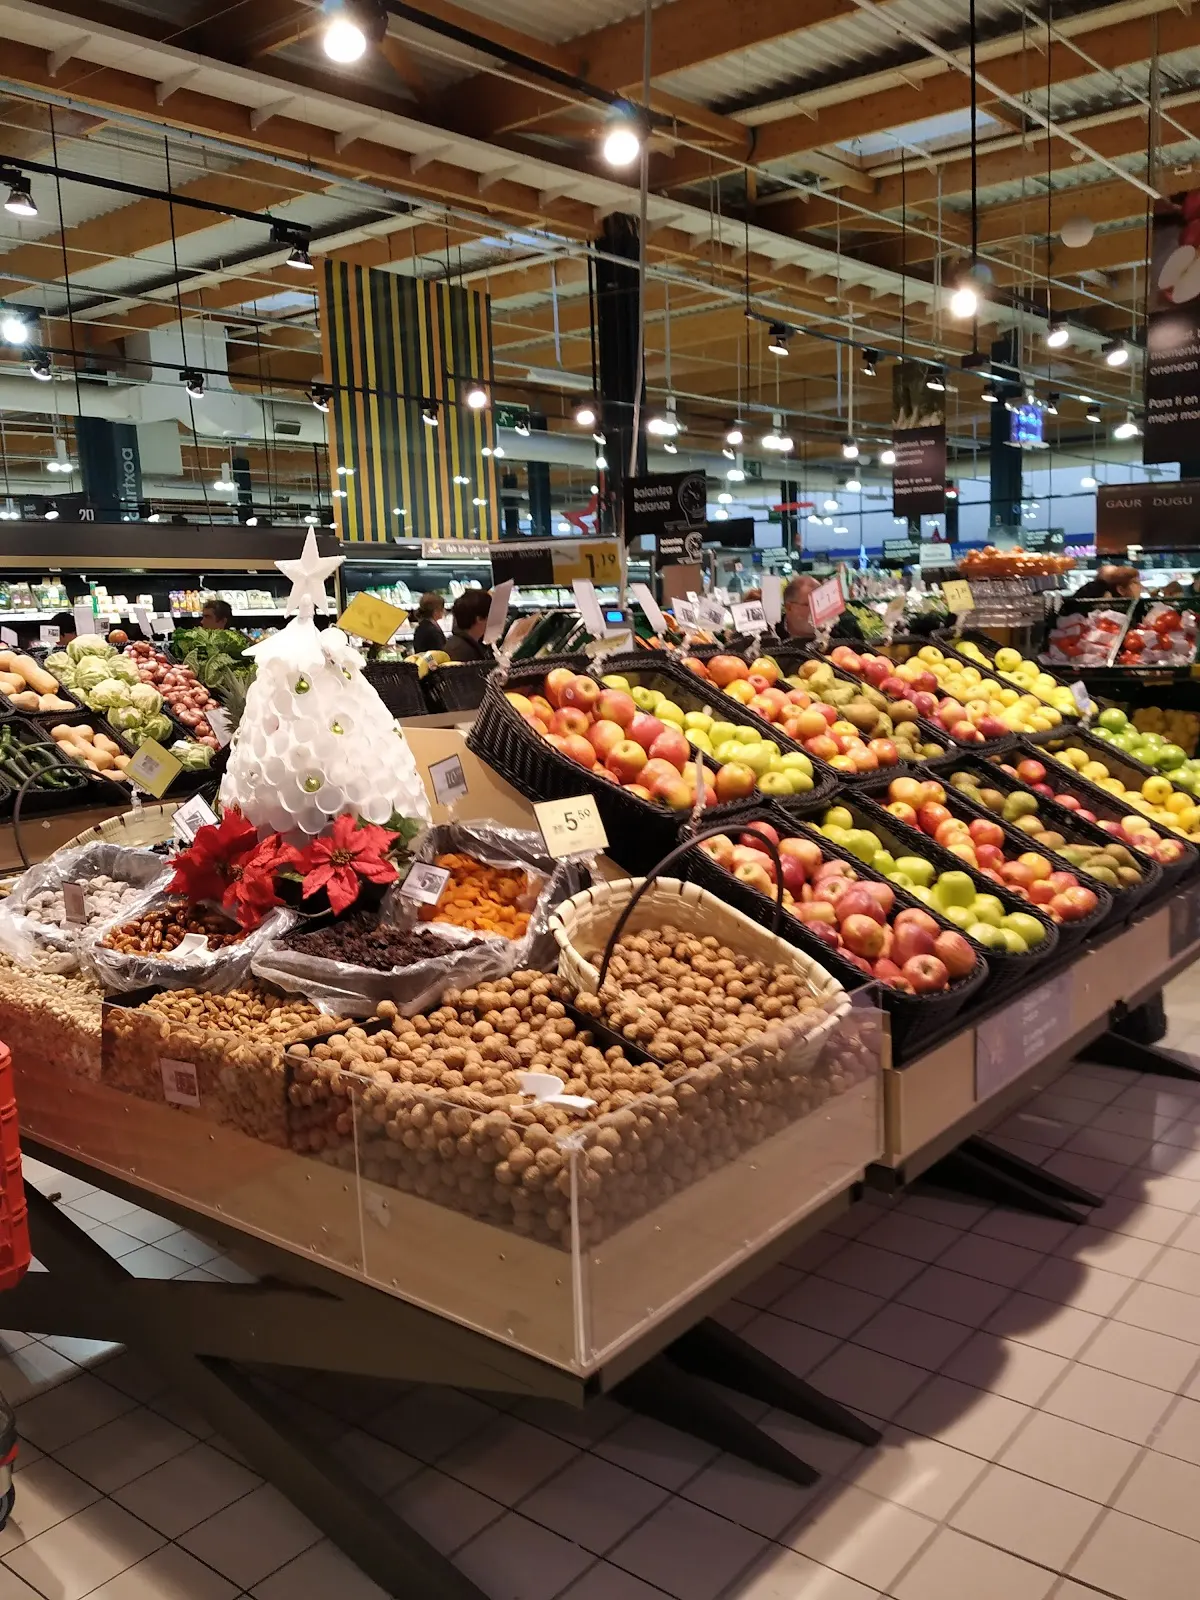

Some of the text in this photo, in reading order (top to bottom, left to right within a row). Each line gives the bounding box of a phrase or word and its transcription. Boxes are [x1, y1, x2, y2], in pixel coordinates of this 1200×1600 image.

[633, 485, 673, 499] Balantza
[633, 501, 671, 513] Balanza
[1105, 496, 1193, 509] GAUR DUGU
